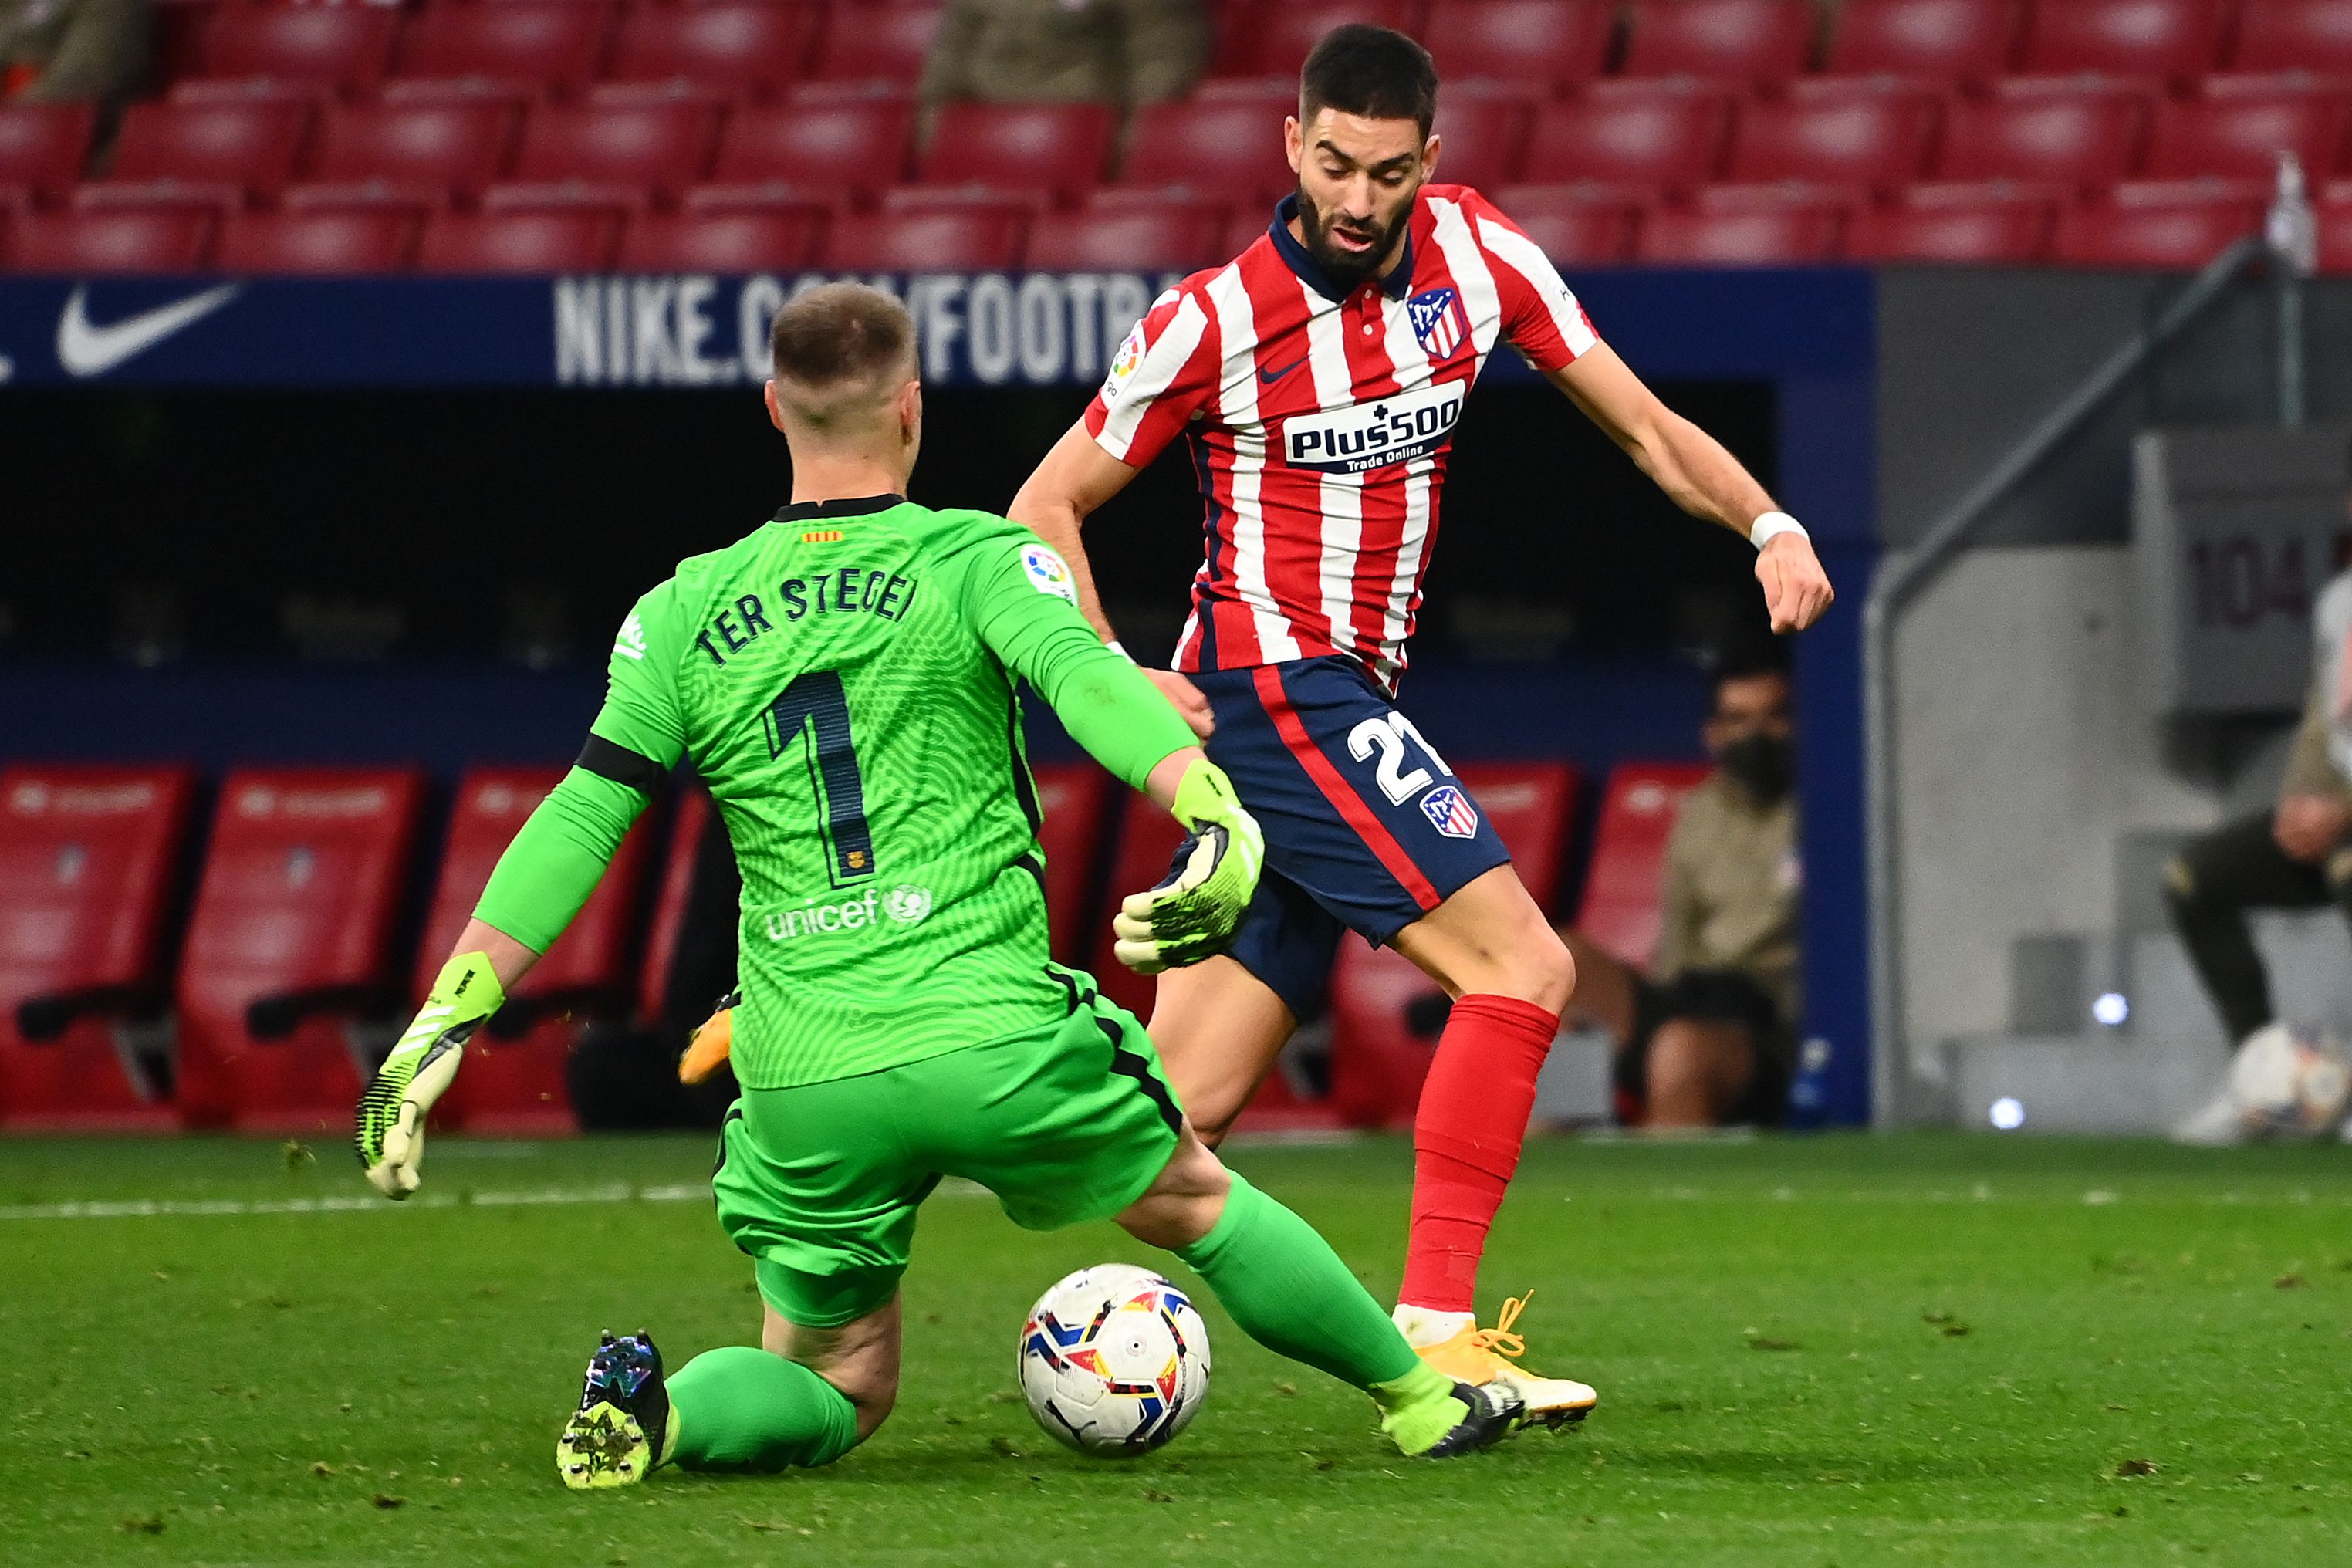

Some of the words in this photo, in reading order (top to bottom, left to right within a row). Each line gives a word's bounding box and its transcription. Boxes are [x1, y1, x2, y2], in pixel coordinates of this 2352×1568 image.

[1292, 398, 1459, 458] Plus500
[1347, 454, 1384, 472] Trade
[1386, 444, 1424, 463] Online
[694, 594, 774, 668] TER
[763, 668, 878, 891] 1
[764, 888, 878, 941] unicef
